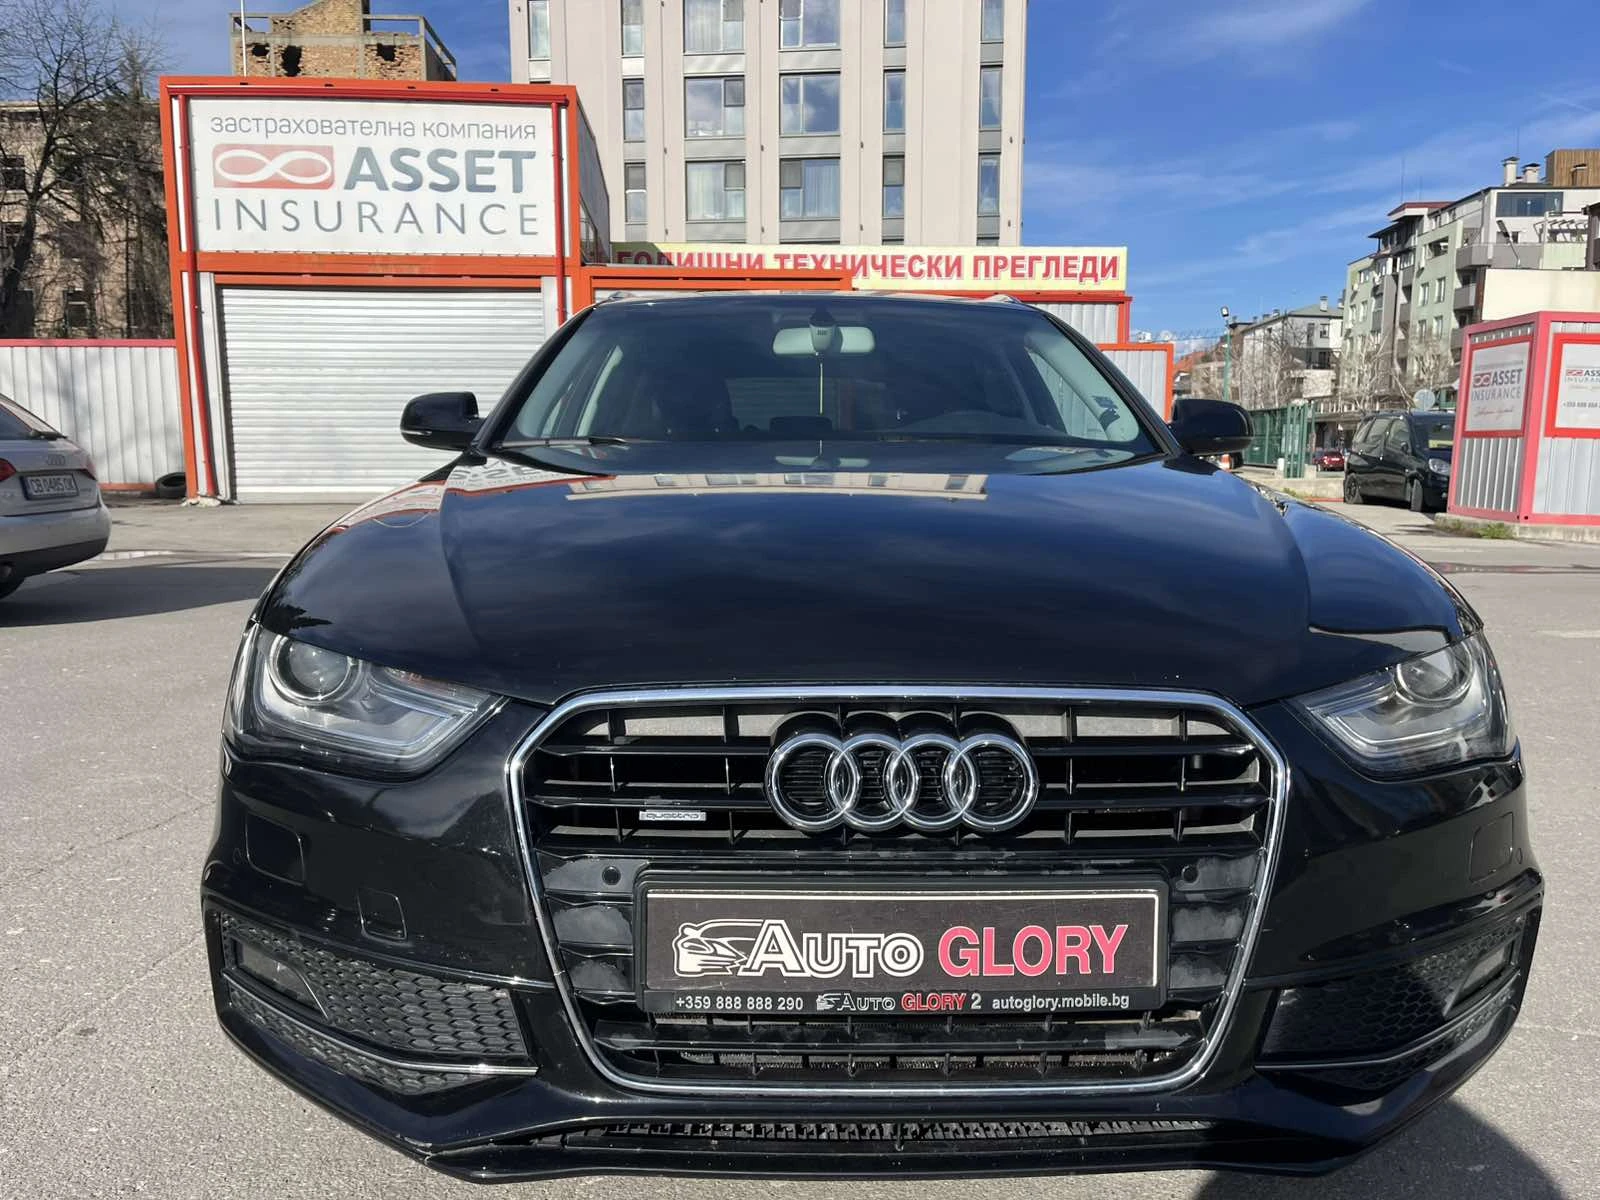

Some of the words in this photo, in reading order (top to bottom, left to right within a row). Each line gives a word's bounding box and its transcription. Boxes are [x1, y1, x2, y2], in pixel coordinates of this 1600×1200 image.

[210, 115, 415, 139] застрахователна
[423, 120, 537, 139] компания
[343, 146, 537, 194] ASSET
[213, 198, 539, 236] INSURANCE
[773, 253, 963, 278] ТЕХНИЧЕСКИ
[973, 255, 1119, 283] ПРЕГЛЕДИ
[1491, 368, 1523, 386] ASSET
[938, 923, 1128, 978] GLORY
[676, 996, 711, 1010] +359
[716, 996, 742, 1010] 888
[747, 996, 773, 1010] 888
[777, 997, 803, 1011] 290
[901, 992, 967, 1011] GLORY
[971, 992, 982, 1010] 2
[991, 994, 1130, 1012] autoglory.mobile.bg
